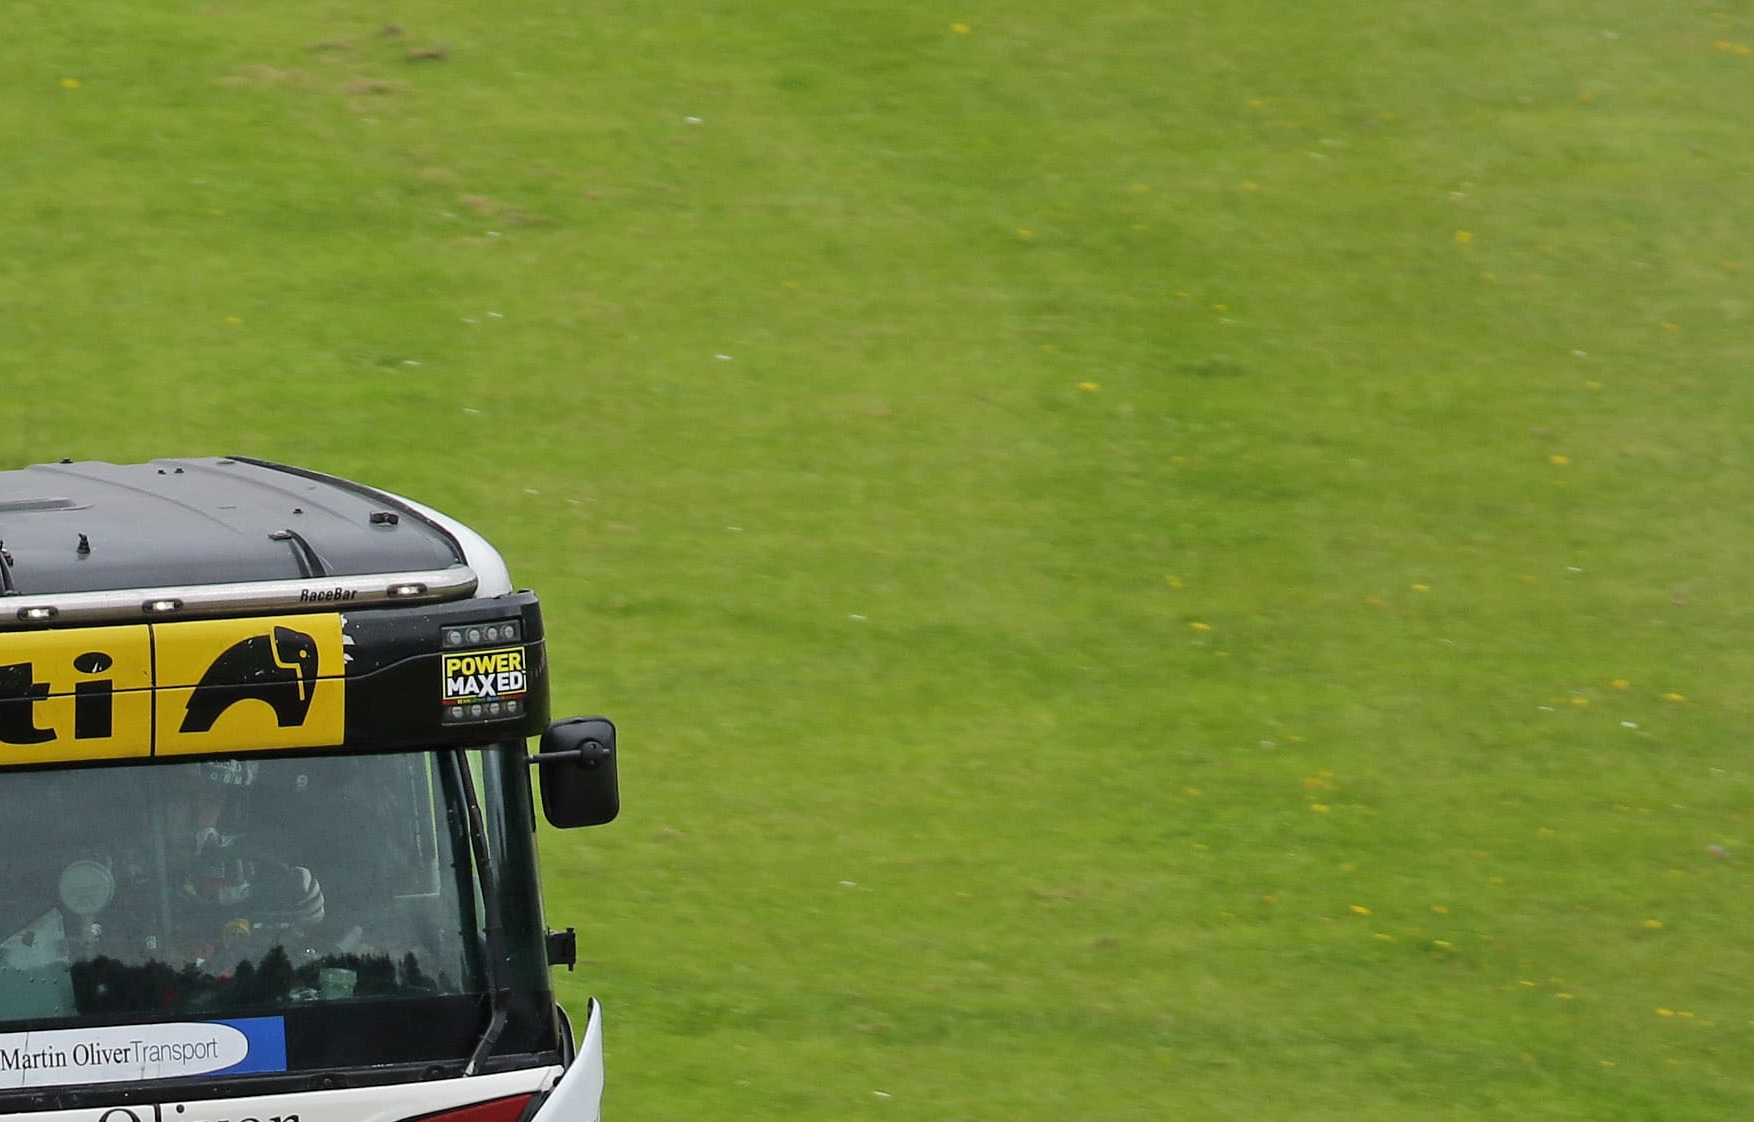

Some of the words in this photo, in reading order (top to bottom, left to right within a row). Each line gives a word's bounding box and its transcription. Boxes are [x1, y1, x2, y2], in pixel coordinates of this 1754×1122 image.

[300, 587, 358, 601] RaceBar
[447, 652, 521, 677] POWER
[447, 671, 523, 698] MAXED
[0, 1045, 66, 1072] Martin
